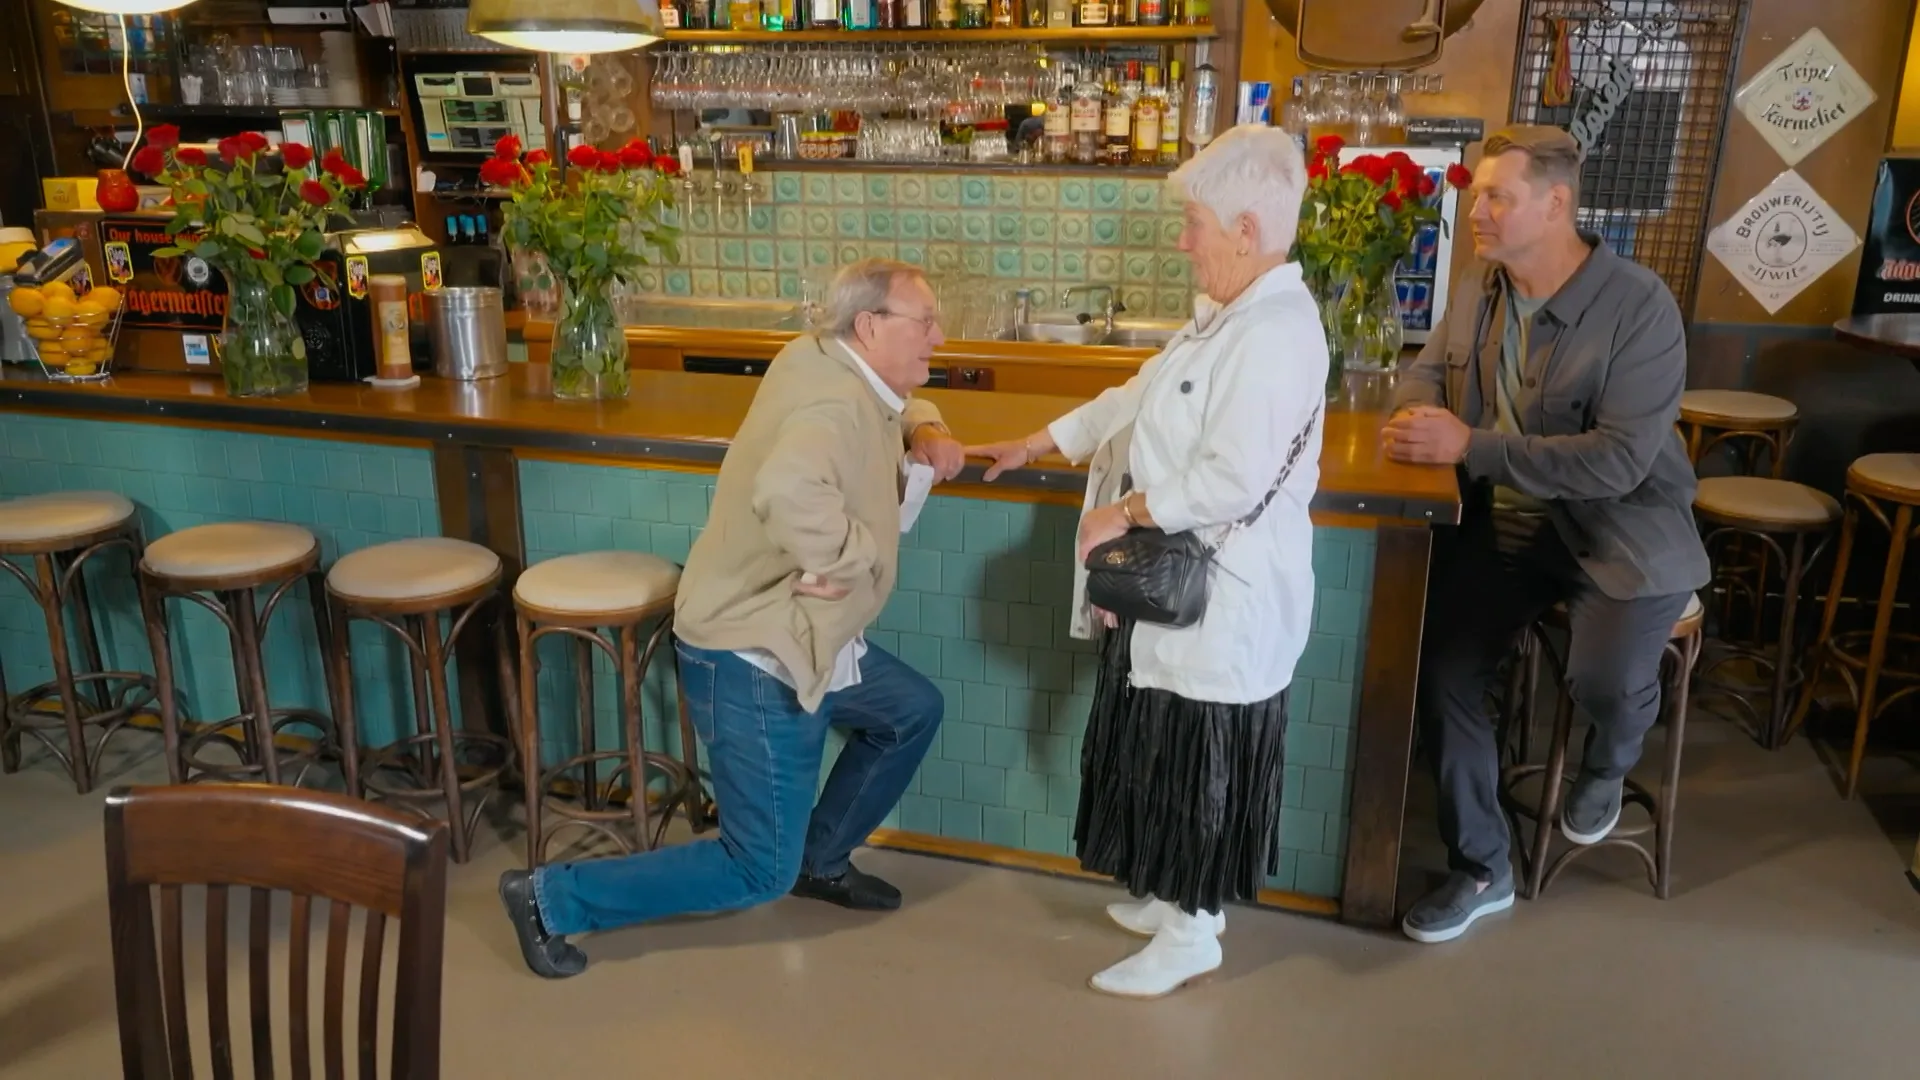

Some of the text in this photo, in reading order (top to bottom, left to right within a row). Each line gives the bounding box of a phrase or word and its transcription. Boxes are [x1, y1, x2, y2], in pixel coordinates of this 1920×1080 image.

[1776, 61, 1838, 83] Tripel
[1761, 102, 1846, 131] Karmeliet
[109, 228, 131, 242] Our
[134, 228, 173, 244] house
